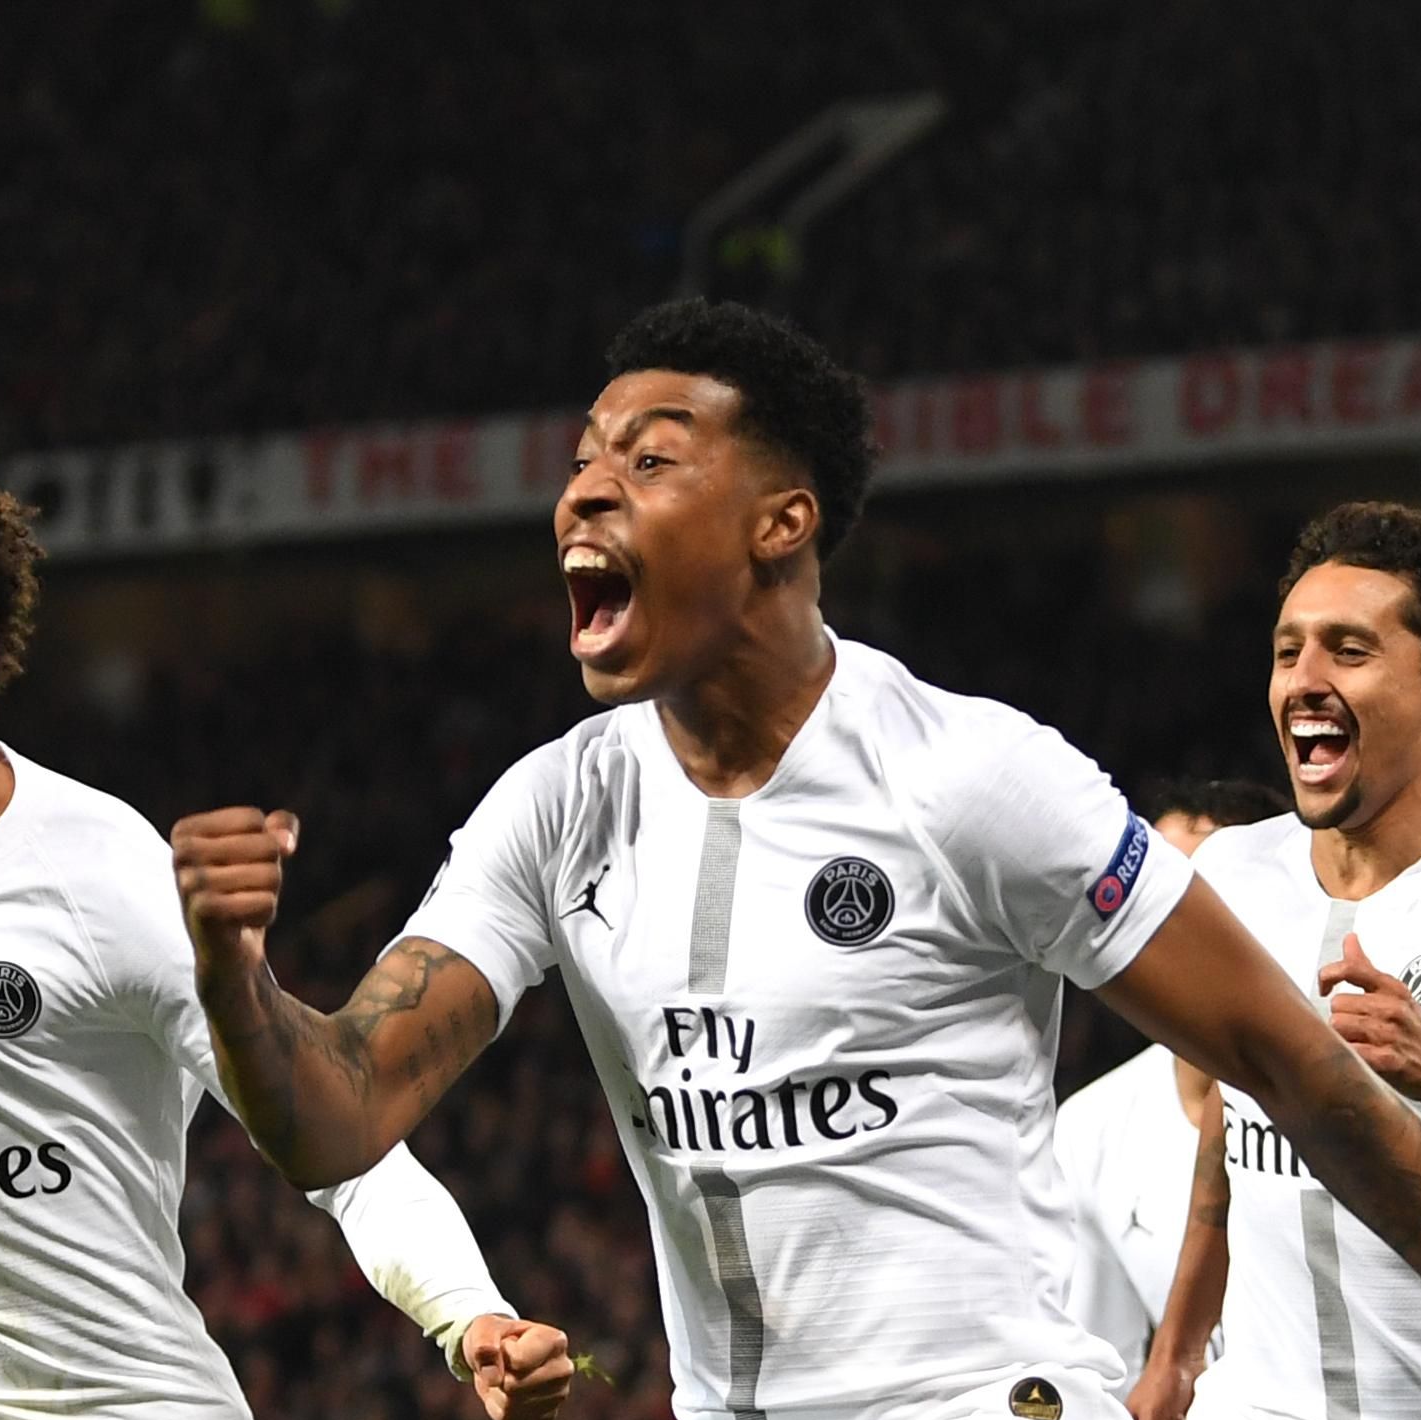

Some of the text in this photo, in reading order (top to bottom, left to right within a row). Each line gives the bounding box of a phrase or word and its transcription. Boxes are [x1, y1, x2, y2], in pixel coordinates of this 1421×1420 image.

[296, 424, 483, 512] THE
[823, 864, 880, 887] PARIS
[662, 1007, 755, 1074] Fly
